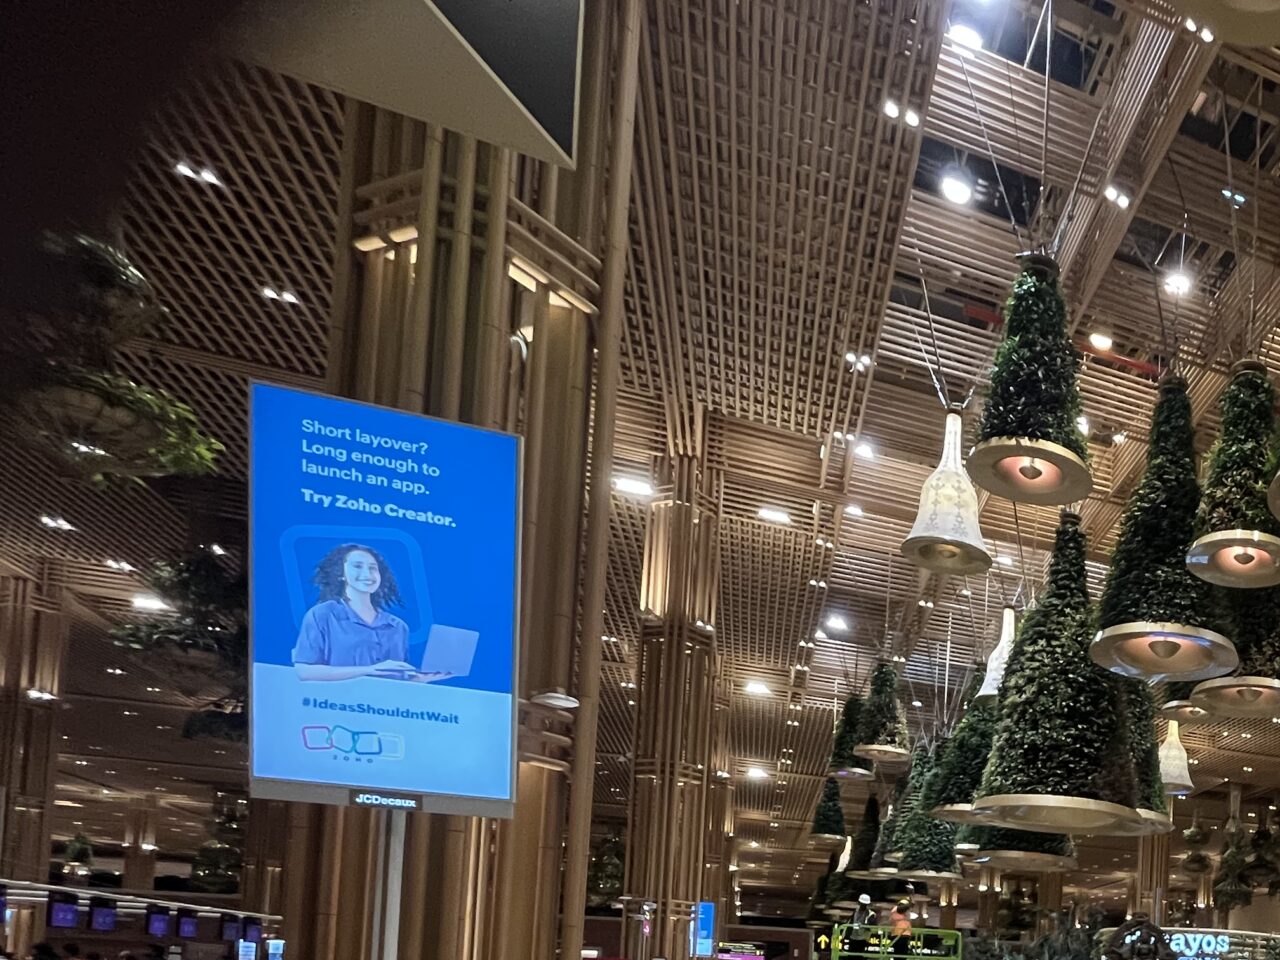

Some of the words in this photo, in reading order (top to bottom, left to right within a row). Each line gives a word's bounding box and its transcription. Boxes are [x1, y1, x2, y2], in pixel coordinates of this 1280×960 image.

[302, 419, 352, 440] Short
[355, 428, 429, 455] layover?
[302, 439, 347, 462] Long
[351, 451, 419, 473] enough
[422, 463, 441, 477] to
[302, 459, 363, 482] launch
[366, 474, 388, 487] an
[391, 478, 430, 495] app.
[301, 488, 333, 508] Try
[335, 494, 382, 514] Zoho
[384, 503, 457, 528] Creator.
[302, 697, 460, 724] #IdeasShouldntWait
[355, 794, 417, 808] JCDecaux
